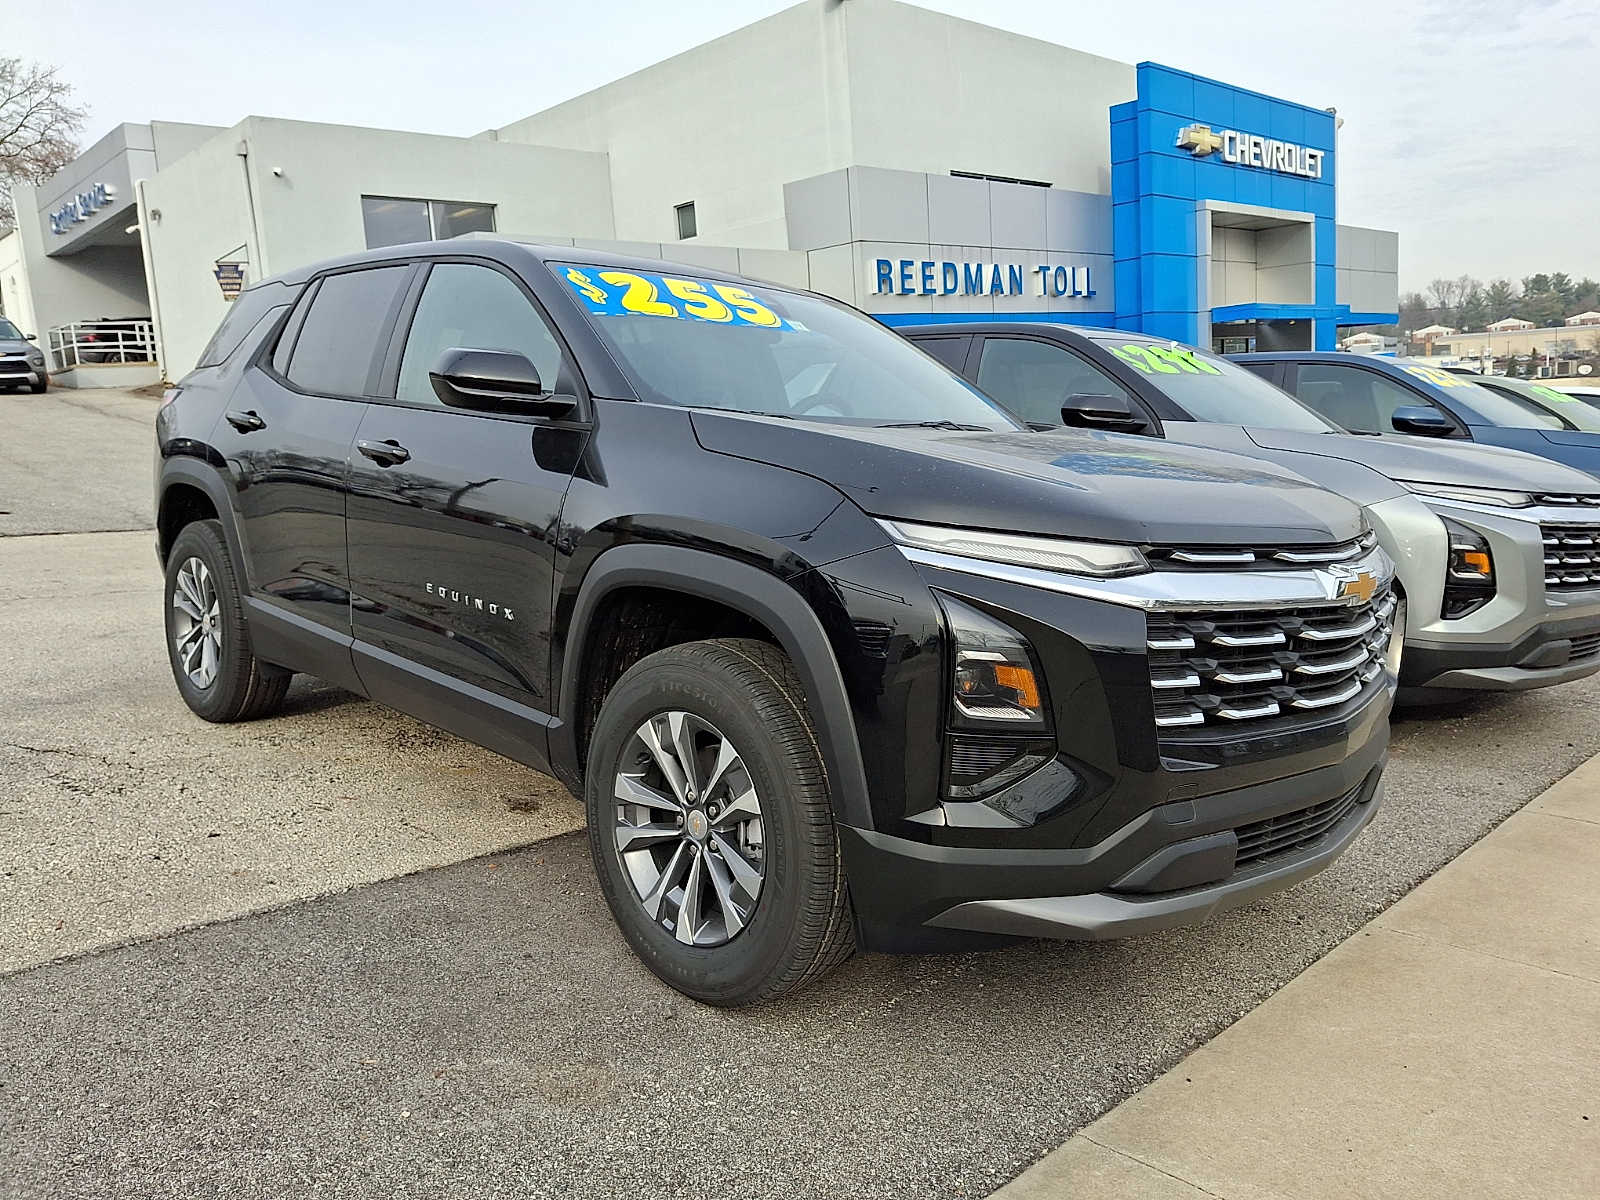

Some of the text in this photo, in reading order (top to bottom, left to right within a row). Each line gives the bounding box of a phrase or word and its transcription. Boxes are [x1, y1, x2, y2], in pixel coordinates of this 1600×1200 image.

[1223, 130, 1325, 178] CHEVROLET
[566, 267, 782, 328] $255
[873, 258, 1097, 297] REEDMAN TOLL
[426, 582, 514, 621] EQUINOX
